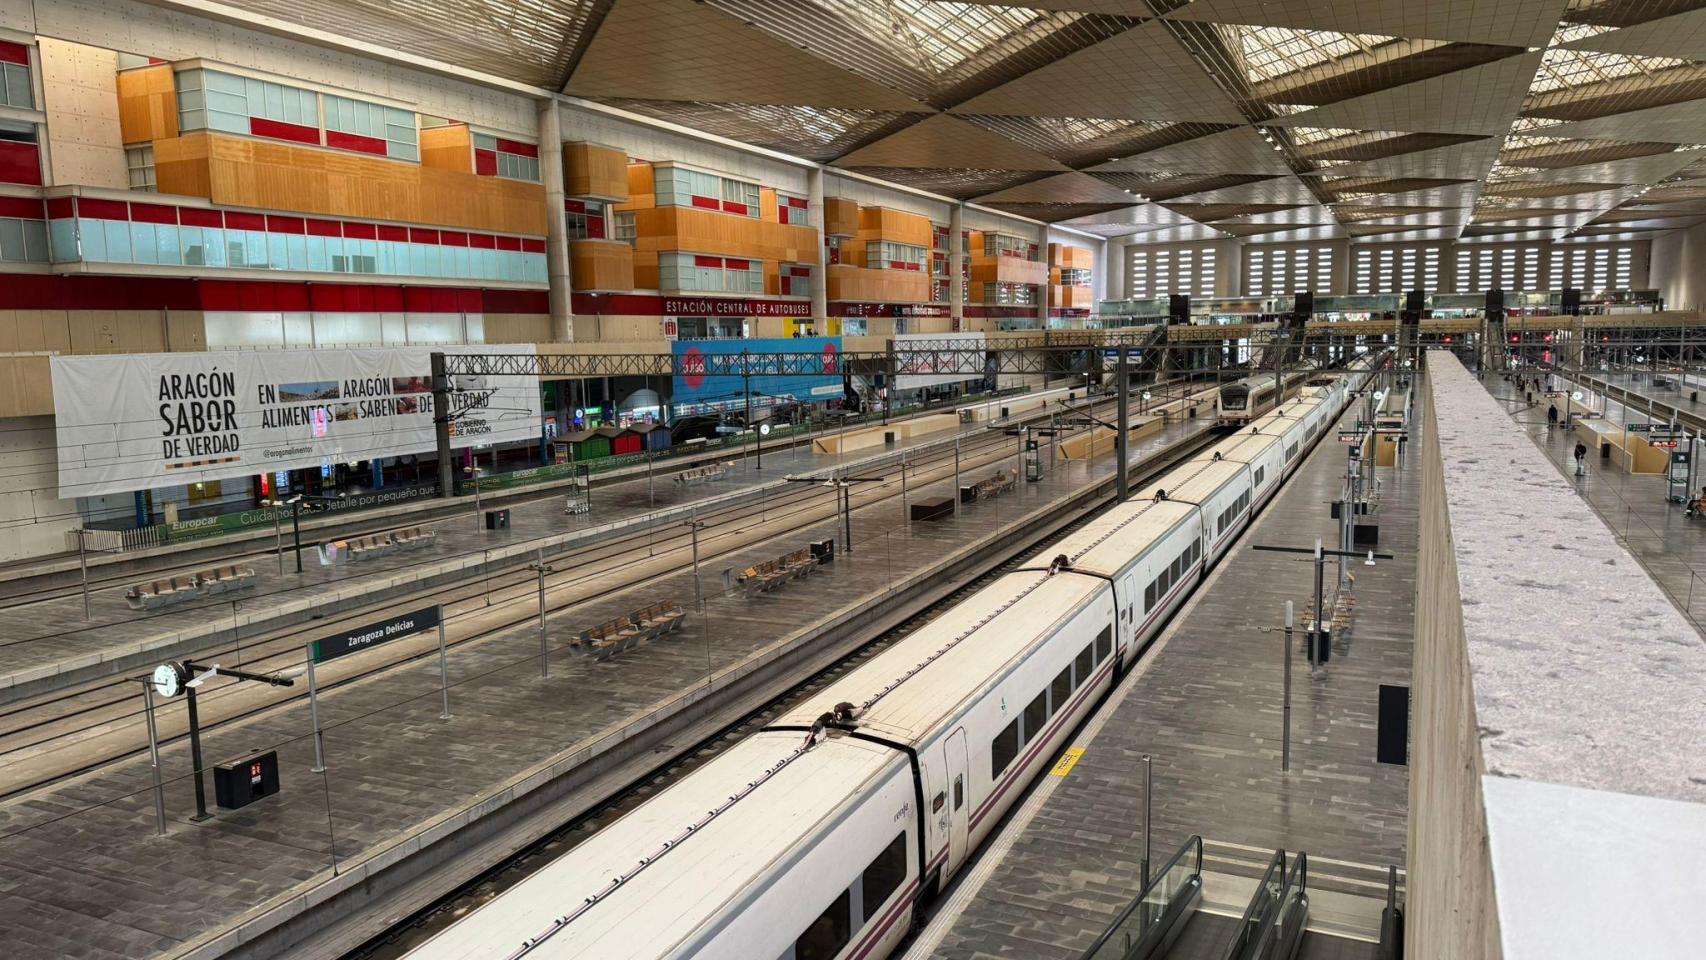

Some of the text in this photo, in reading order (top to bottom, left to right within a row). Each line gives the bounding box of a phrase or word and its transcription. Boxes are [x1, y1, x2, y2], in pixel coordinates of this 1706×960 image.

[666, 301, 809, 314] ESTACIÓN CENTRAL DE AUTOBUSES
[159, 366, 236, 401] ARAGÓN
[258, 374, 391, 405] EN ARAGÓN
[159, 400, 238, 436] SABOR
[262, 392, 489, 429] ALIMENTOS SABEN DE VERDAD
[163, 433, 240, 459] DE VERDAD
[240, 508, 295, 525] Cuidamos
[359, 495, 376, 509] por
[378, 487, 418, 504] pequeño
[420, 485, 436, 499] que
[172, 516, 218, 530] Europcar
[348, 620, 414, 647] Zaragoza Delicias
